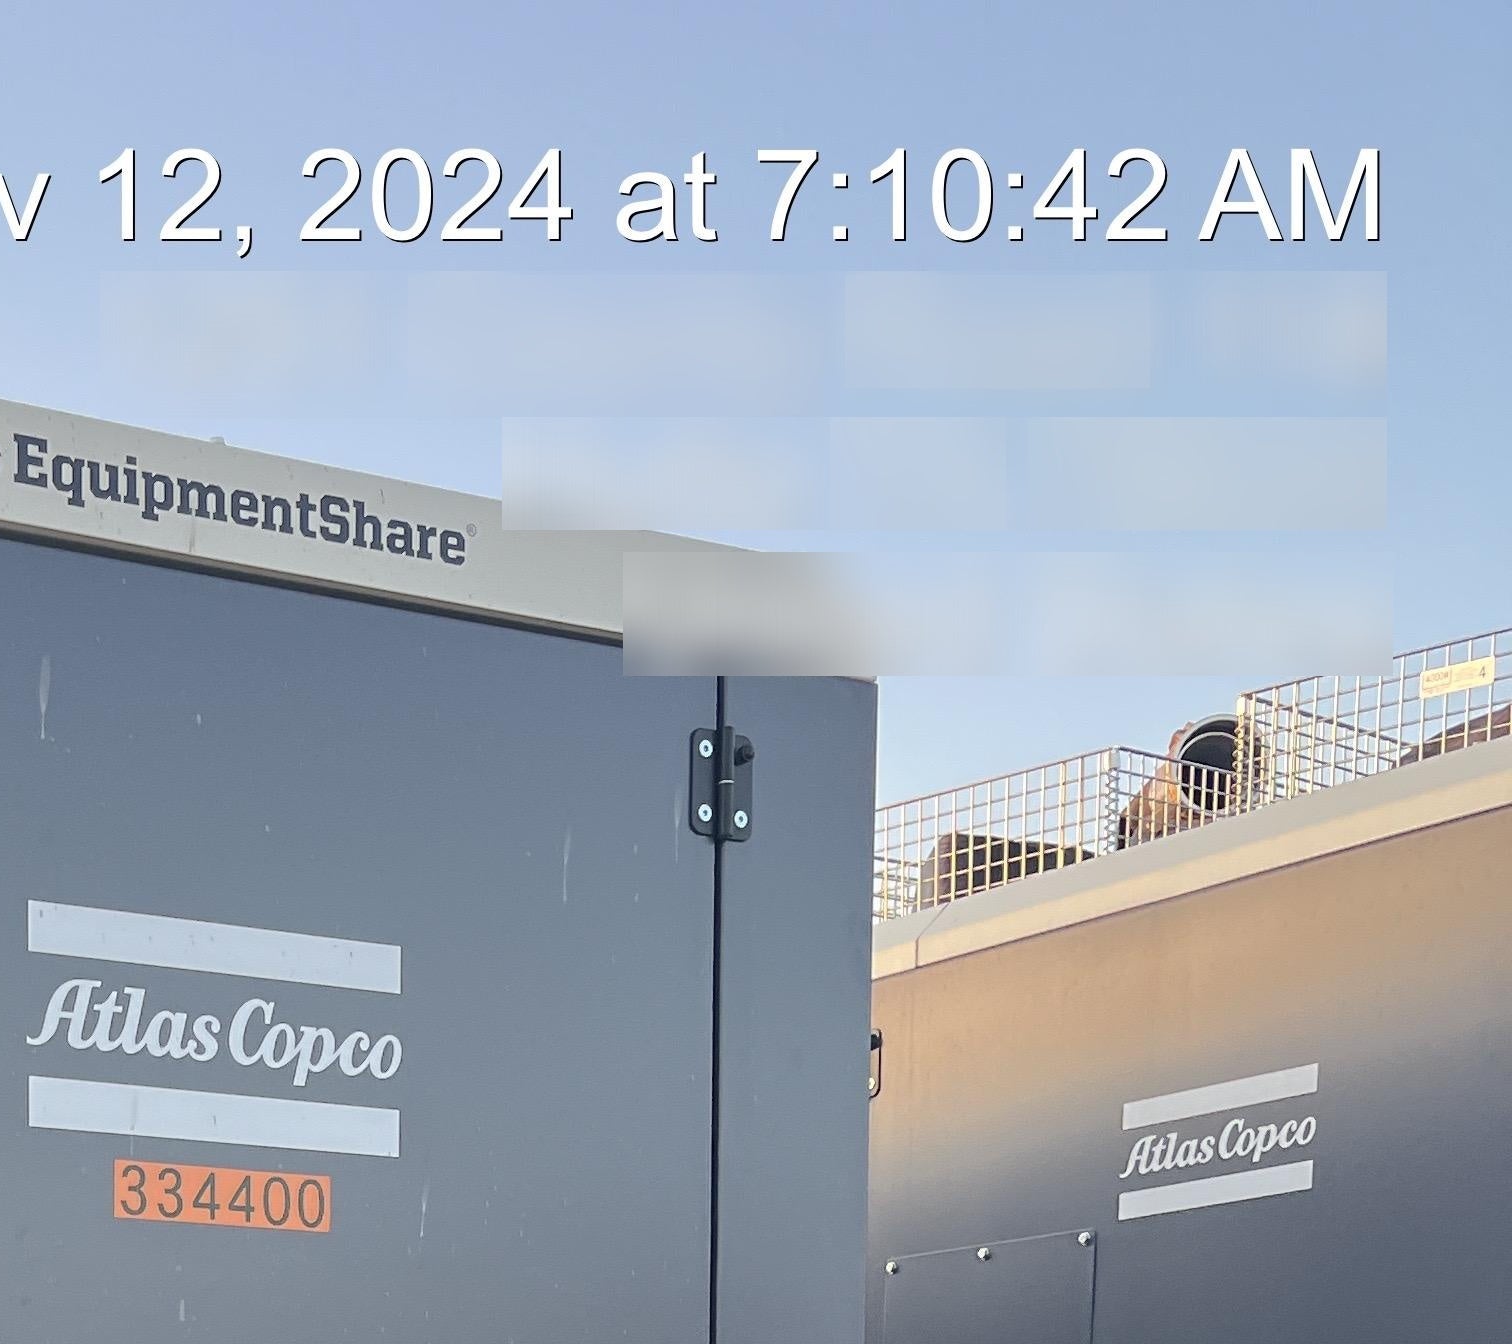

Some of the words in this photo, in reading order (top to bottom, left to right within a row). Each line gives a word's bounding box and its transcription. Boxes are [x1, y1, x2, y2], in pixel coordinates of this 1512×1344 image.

[13, 433, 466, 566] EquipmentShare
[26, 978, 221, 1061] Atlas
[228, 998, 403, 1086] Copco
[1119, 1132, 1215, 1179] Atlas
[1218, 1116, 1317, 1163] Copco
[120, 1164, 326, 1228] 334400
